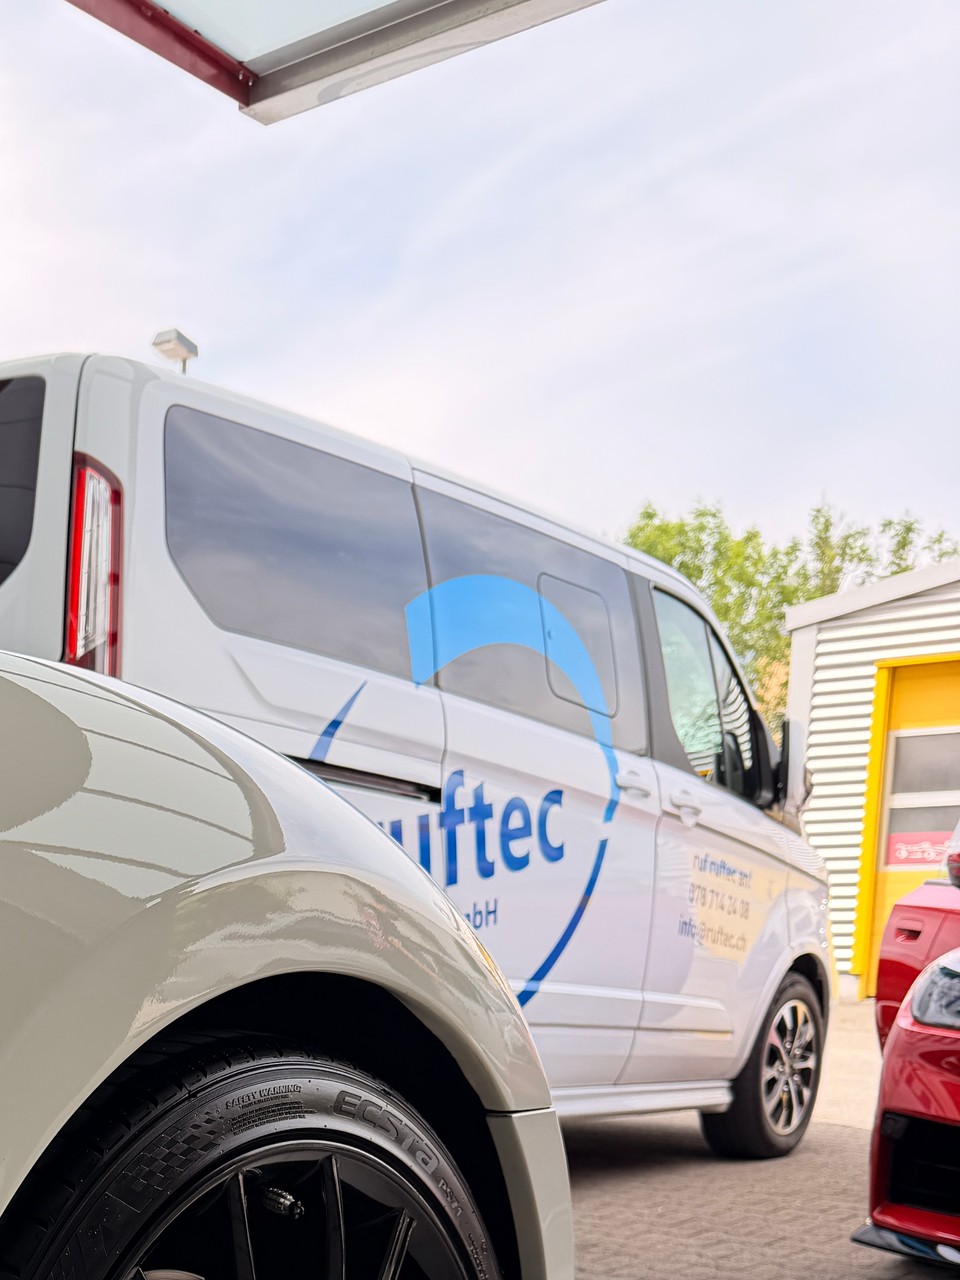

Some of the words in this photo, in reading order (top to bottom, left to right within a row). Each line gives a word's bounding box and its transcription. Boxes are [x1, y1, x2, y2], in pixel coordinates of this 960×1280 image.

[377, 769, 565, 886] uftec
[225, 1090, 260, 1110] SAFETY
[259, 1083, 303, 1101] WARNING
